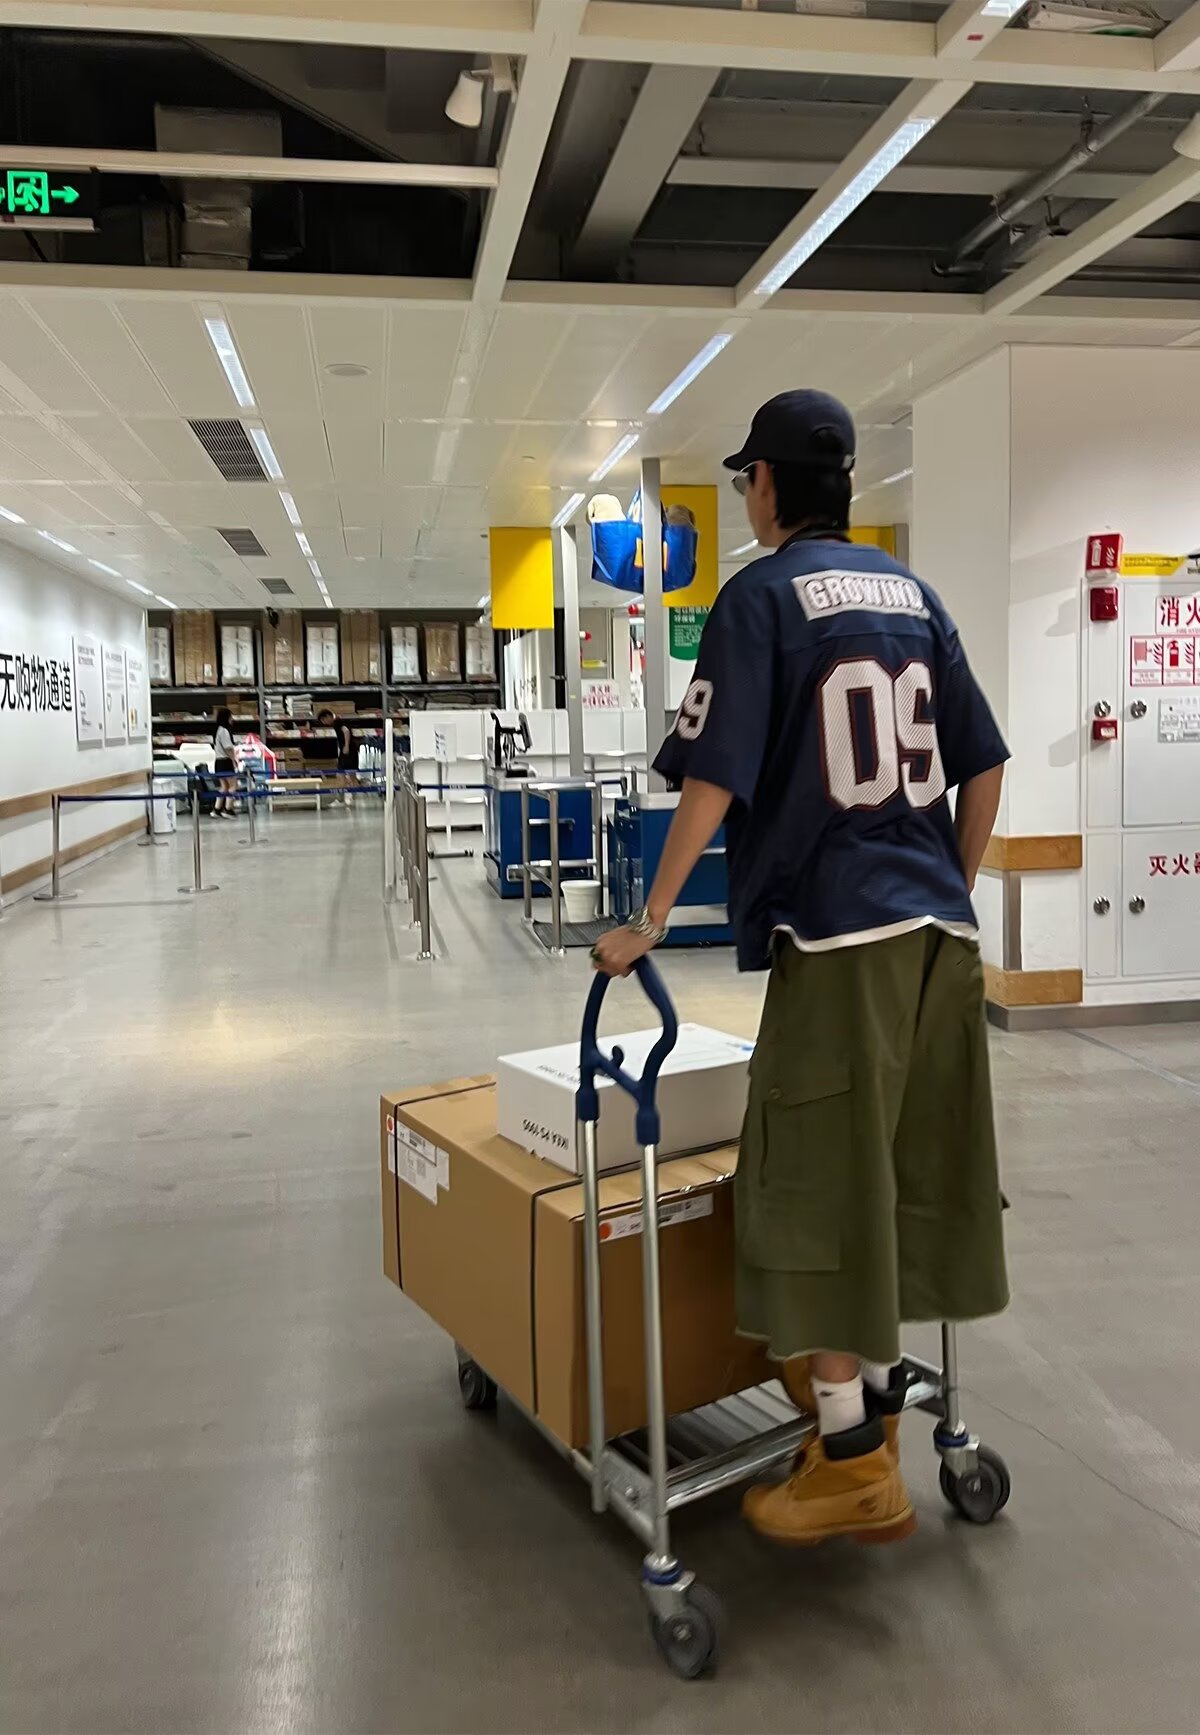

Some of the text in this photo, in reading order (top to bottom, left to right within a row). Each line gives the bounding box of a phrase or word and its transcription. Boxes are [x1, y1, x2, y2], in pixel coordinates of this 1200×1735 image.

[0, 653, 73, 712] 无购物通道
